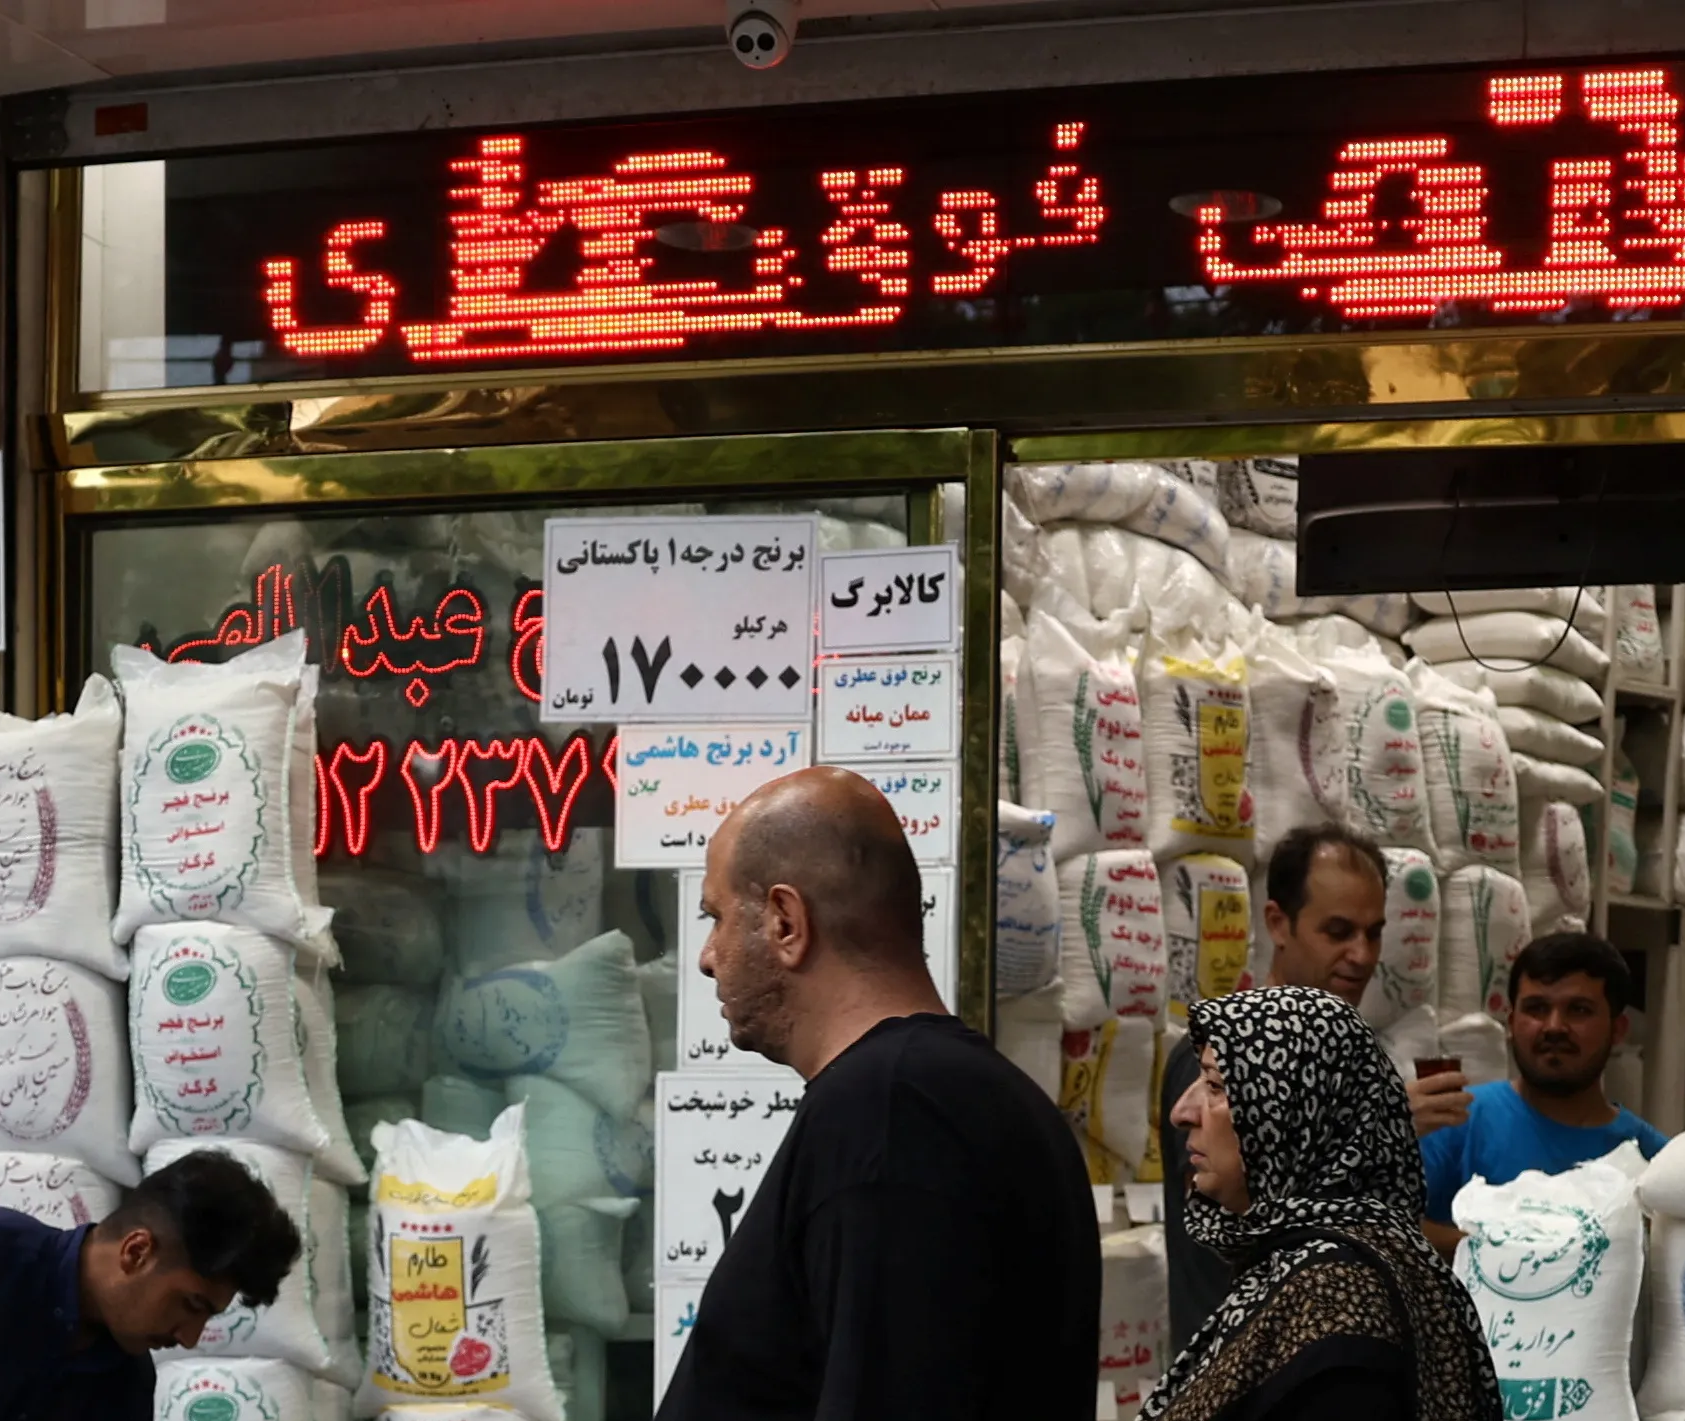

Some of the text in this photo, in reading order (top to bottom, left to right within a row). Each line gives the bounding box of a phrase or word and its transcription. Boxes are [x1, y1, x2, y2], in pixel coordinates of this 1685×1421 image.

[557, 539, 659, 575] پاکستانی
[752, 544, 805, 572] برنج
[830, 572, 945, 617] کالابرگ
[834, 668, 941, 688] برنج فوق عطری
[552, 689, 594, 709] تومان
[626, 732, 799, 766] آرد برنج هاشمی
[628, 779, 660, 796] گیلان
[881, 775, 941, 794] برنج فوق
[664, 796, 711, 816] عطری
[660, 830, 693, 847] است
[40, 962, 68, 995] برنج
[688, 1039, 729, 1061] تومان
[694, 1149, 761, 1167] درجه یک
[408, 1247, 448, 1277] طارم
[667, 1242, 707, 1262] تومان
[393, 1283, 459, 1302] هاشمی
